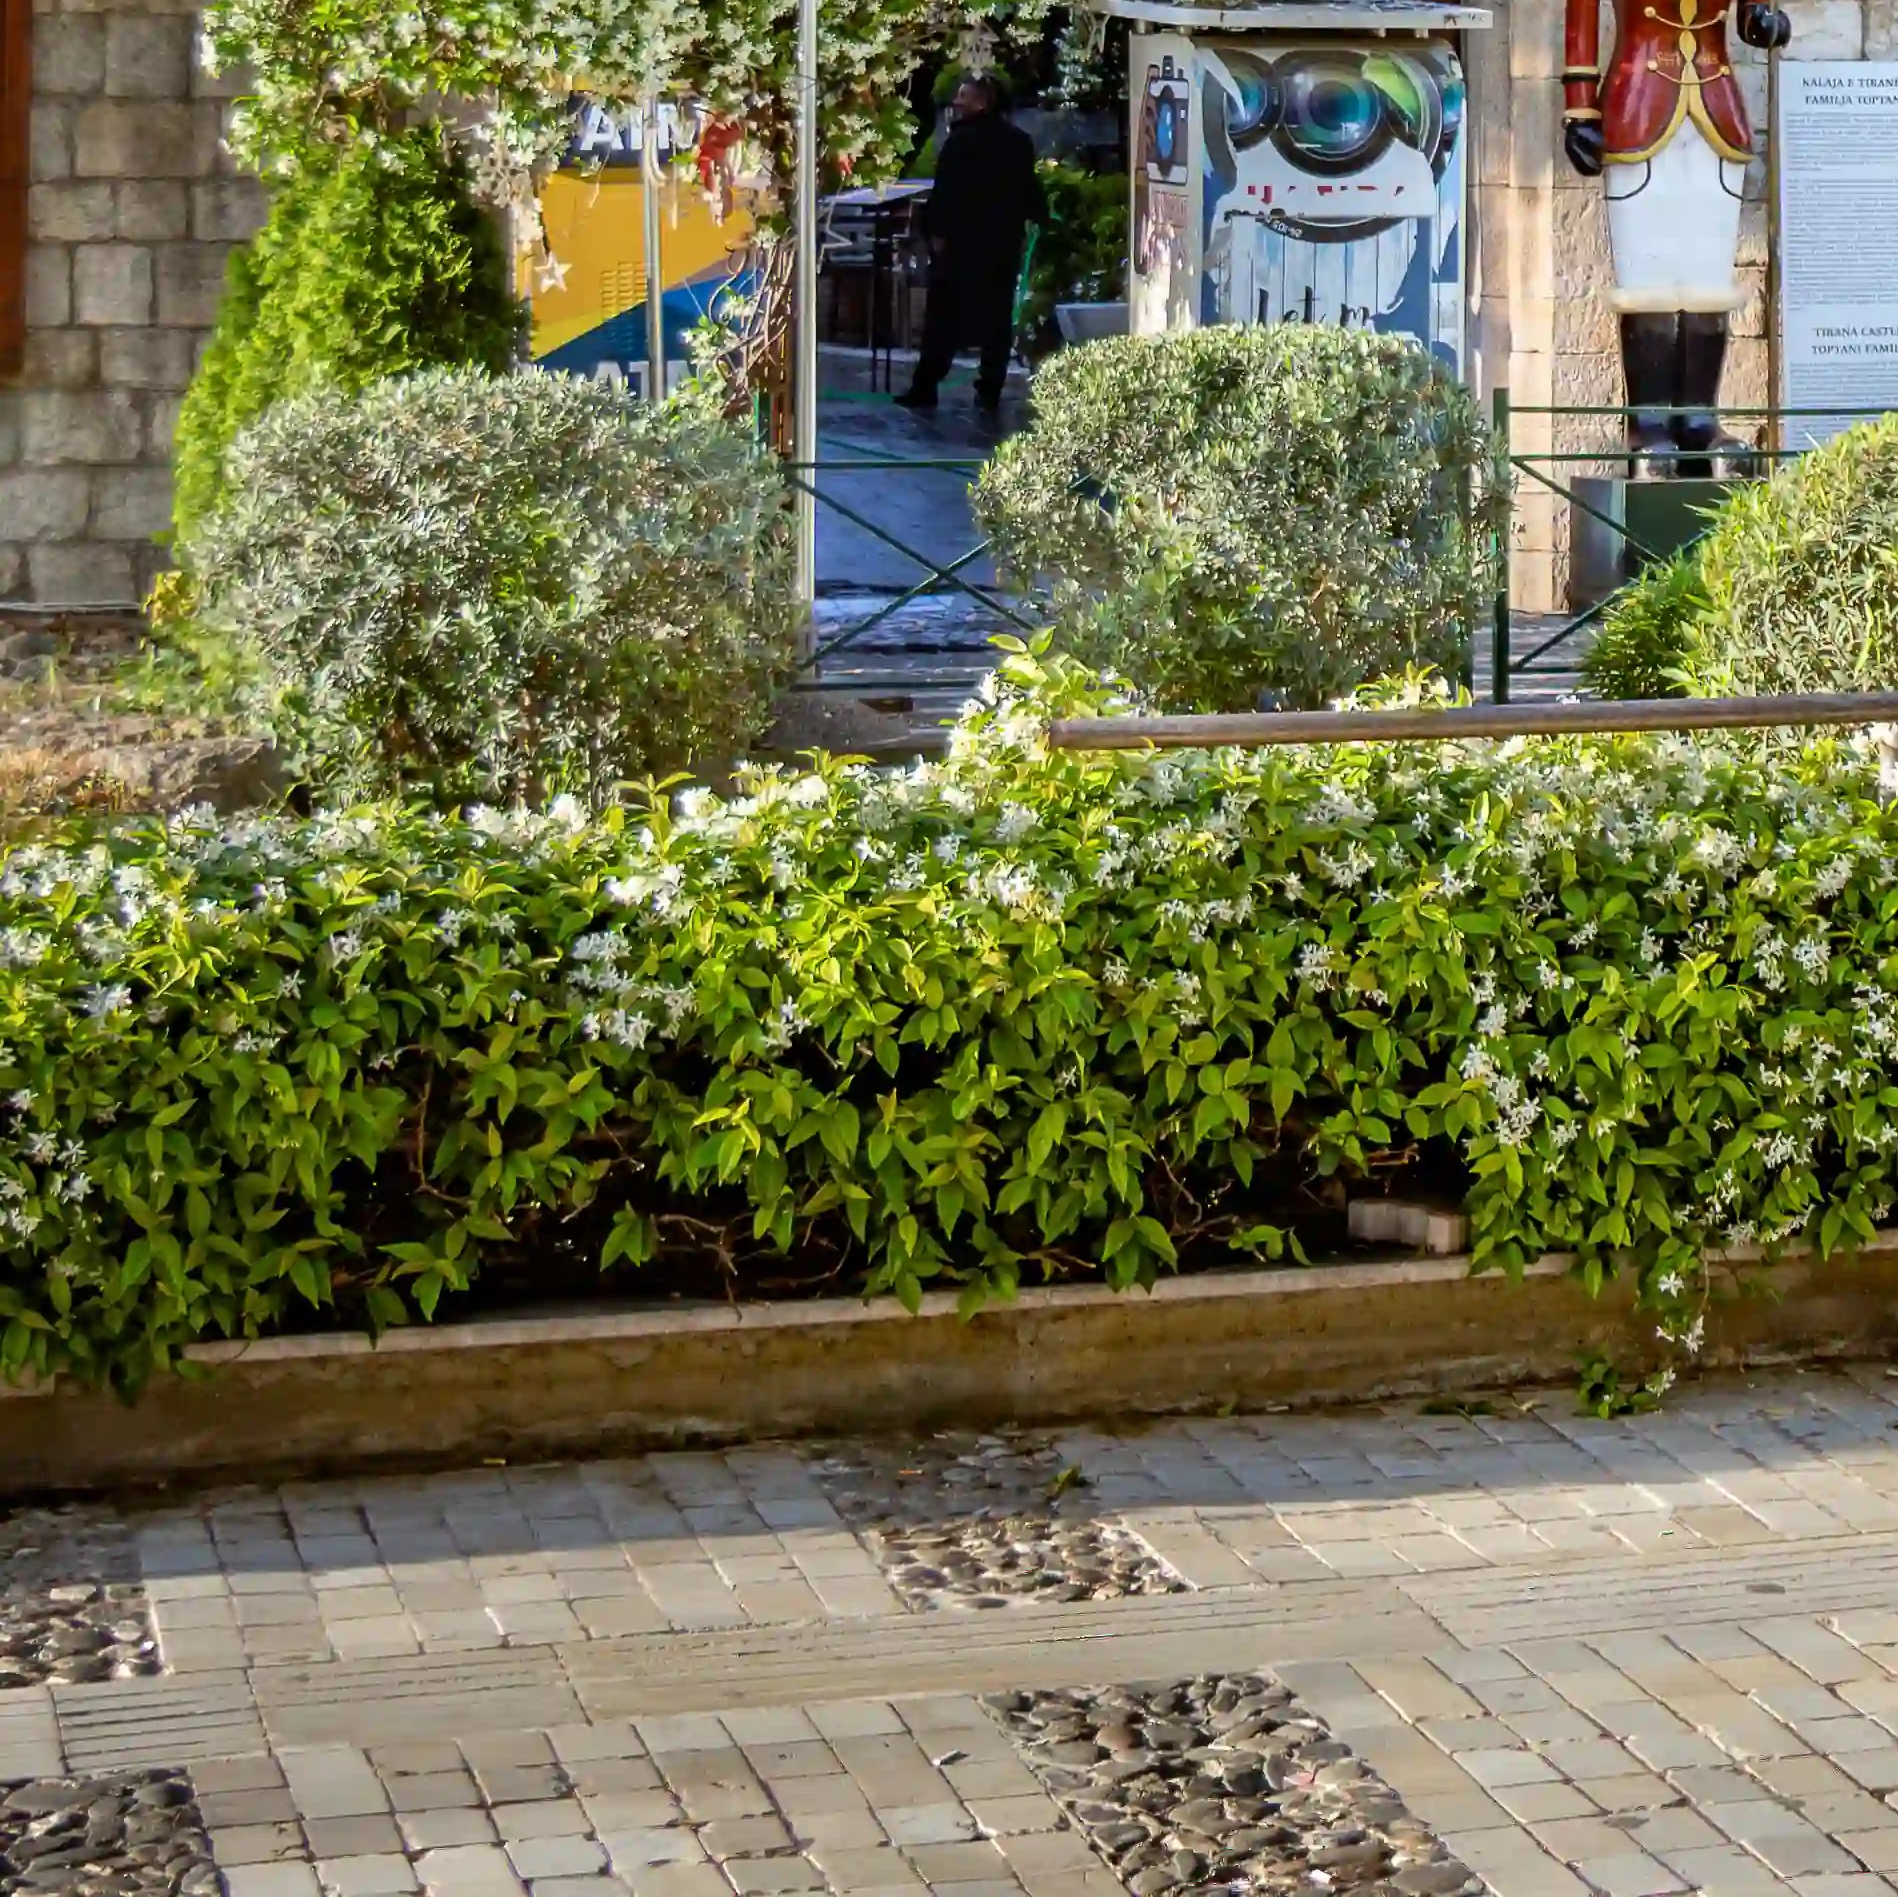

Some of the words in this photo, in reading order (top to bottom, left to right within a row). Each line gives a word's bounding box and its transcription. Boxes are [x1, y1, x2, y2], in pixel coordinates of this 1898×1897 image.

[1802, 76, 1844, 89] KALAJA
[1804, 94, 1853, 107] FAMILJA
[1814, 326, 1858, 338] TIRANA
[1812, 344, 1861, 355] TOPTANI
